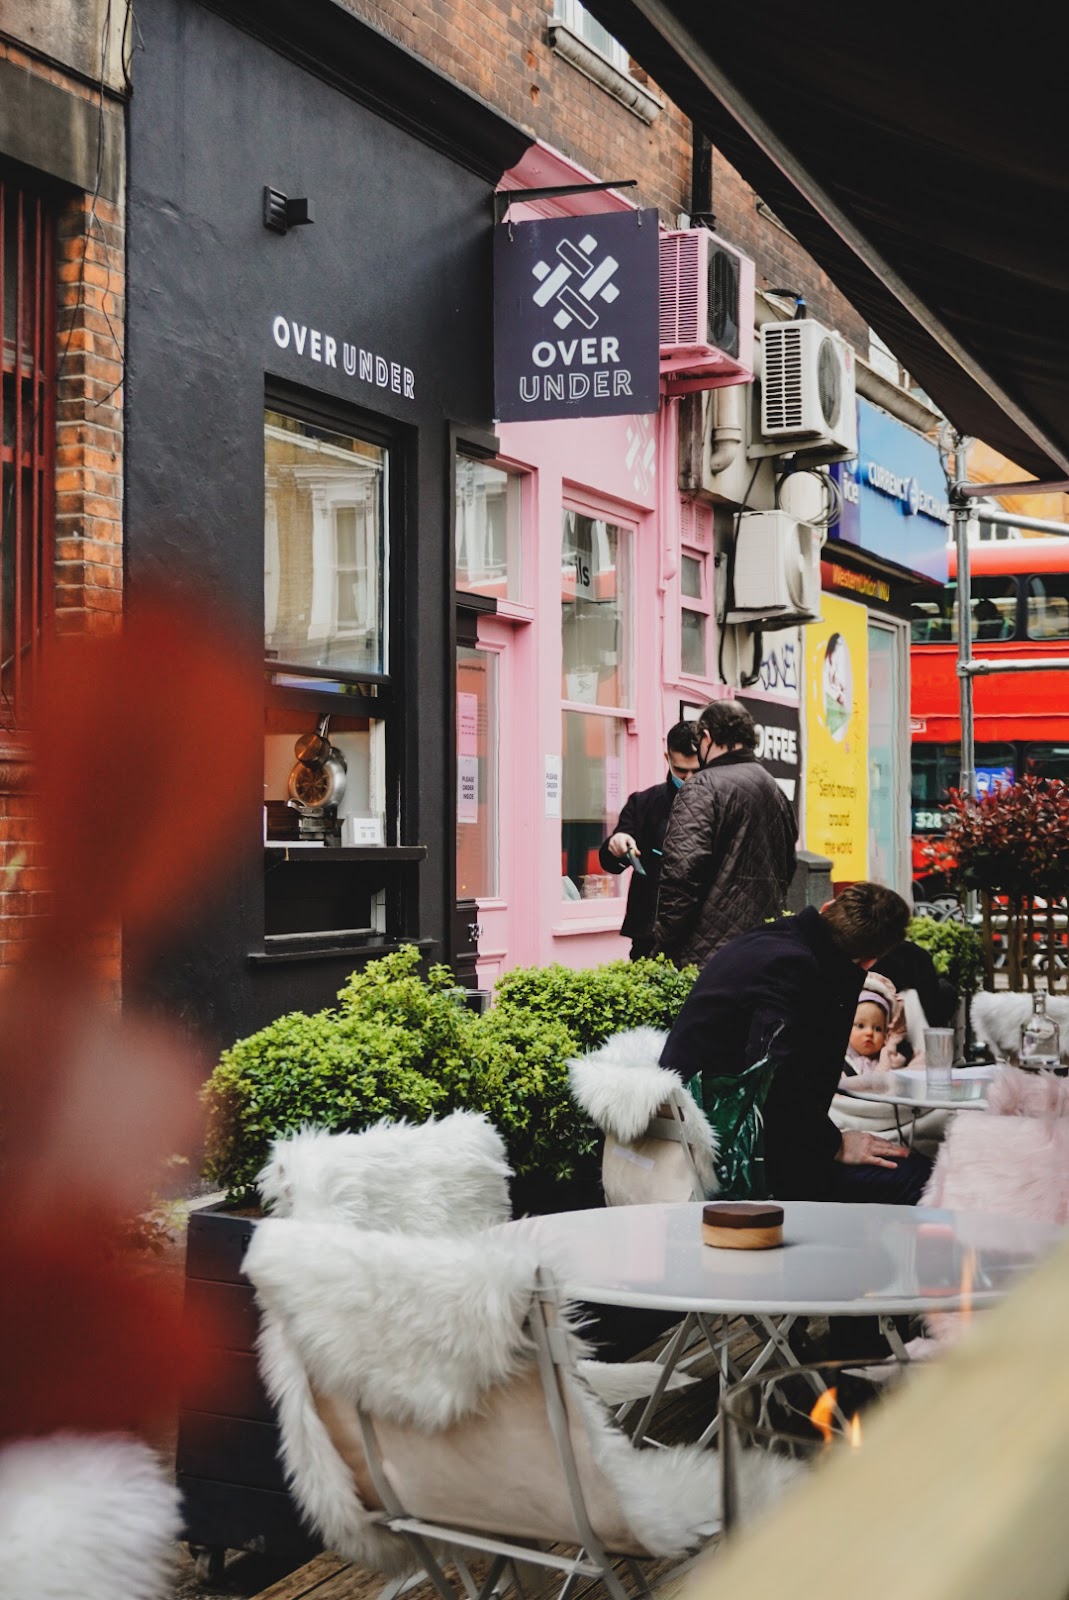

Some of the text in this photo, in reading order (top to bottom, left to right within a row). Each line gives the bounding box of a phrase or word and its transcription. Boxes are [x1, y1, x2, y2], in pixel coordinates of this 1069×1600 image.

[272, 316, 415, 399] OVER UNDER
[531, 335, 621, 368] OVER
[518, 368, 634, 402] UNDER
[843, 471, 859, 504] ice
[753, 723, 798, 765] OFFEE
[819, 778, 857, 803] Send money
[828, 811, 850, 827] around
[914, 811, 942, 829] 328
[824, 838, 853, 855] the world
